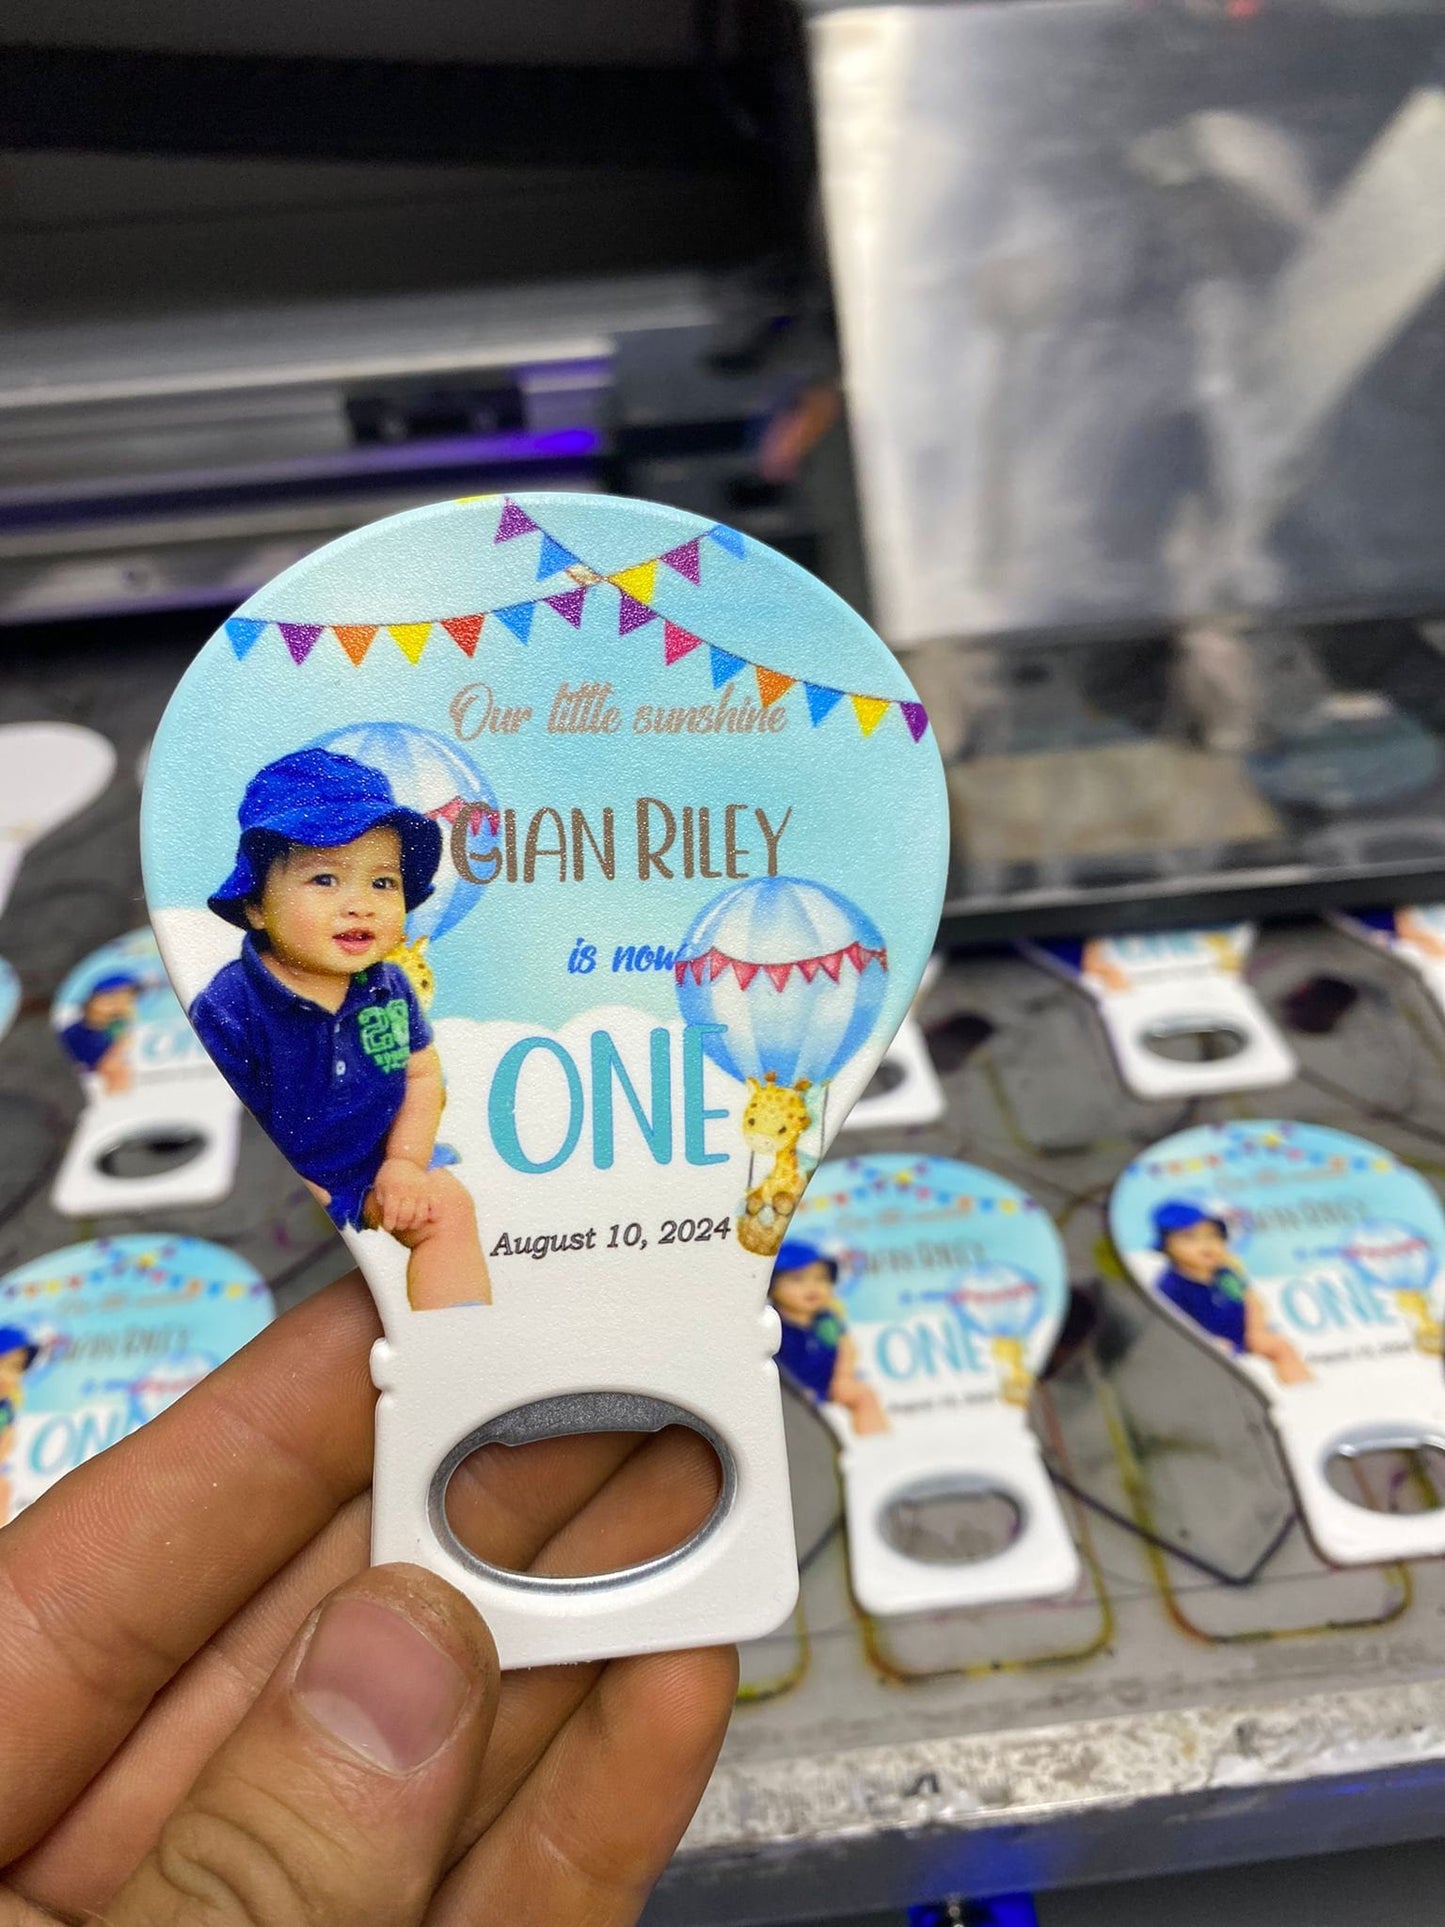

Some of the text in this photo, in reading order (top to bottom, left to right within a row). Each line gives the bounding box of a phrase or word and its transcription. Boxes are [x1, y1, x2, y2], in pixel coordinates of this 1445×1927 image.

[450, 681, 788, 741] Our little sunshine
[450, 797, 793, 885] GIAN RILEY
[567, 938, 688, 974] is now
[488, 1024, 731, 1174] ONE
[490, 1216, 732, 1260] August 10, 2024
